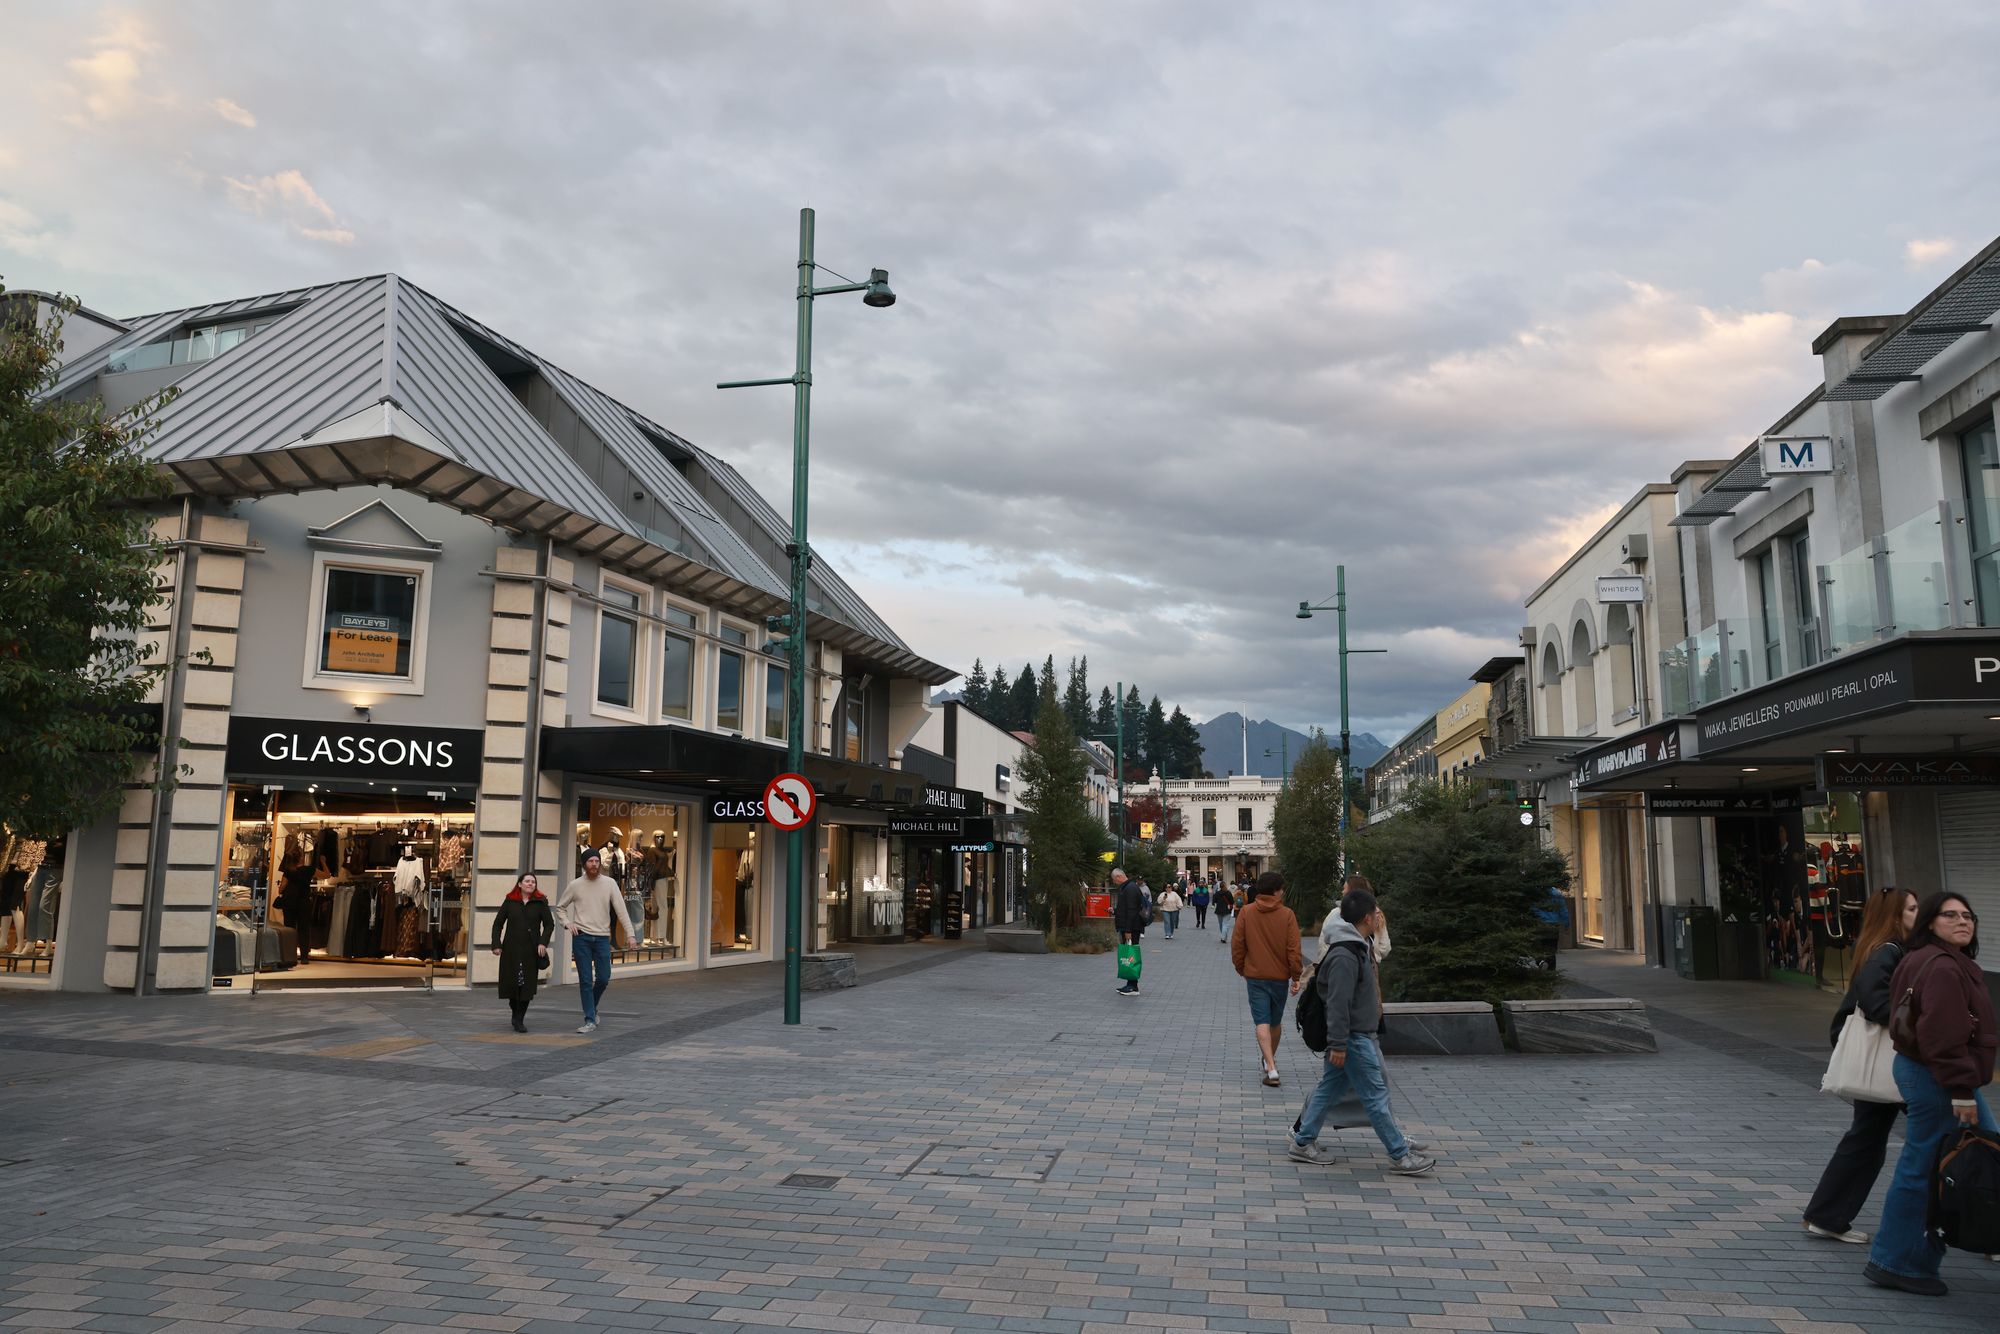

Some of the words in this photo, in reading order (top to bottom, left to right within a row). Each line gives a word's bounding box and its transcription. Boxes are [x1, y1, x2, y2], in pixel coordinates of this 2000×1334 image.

[344, 617, 386, 628] BAYLEYS
[336, 630, 357, 640] For
[360, 631, 393, 643] Lease
[1704, 722, 1727, 739] WAKA
[1728, 703, 1780, 733] JEWELLERS
[1784, 691, 1824, 715] POUNAMU
[1831, 679, 1862, 701] PEARL
[1869, 669, 1898, 689] OPAL
[261, 732, 454, 768] GLASSONS
[1597, 742, 1647, 775] RUGBYPLANET
[1837, 761, 1971, 773] WAKA
[1836, 775, 1905, 784] POUNAMU
[1911, 774, 1953, 783] PEARL
[1960, 774, 1995, 783] OPAL
[950, 792, 966, 810] HILL
[1652, 799, 1726, 808] RUGBYPLANET
[713, 801, 765, 817] GLASS
[892, 822, 935, 831] MICHAEL
[937, 822, 959, 831] HILL
[873, 902, 904, 926] MUMS
